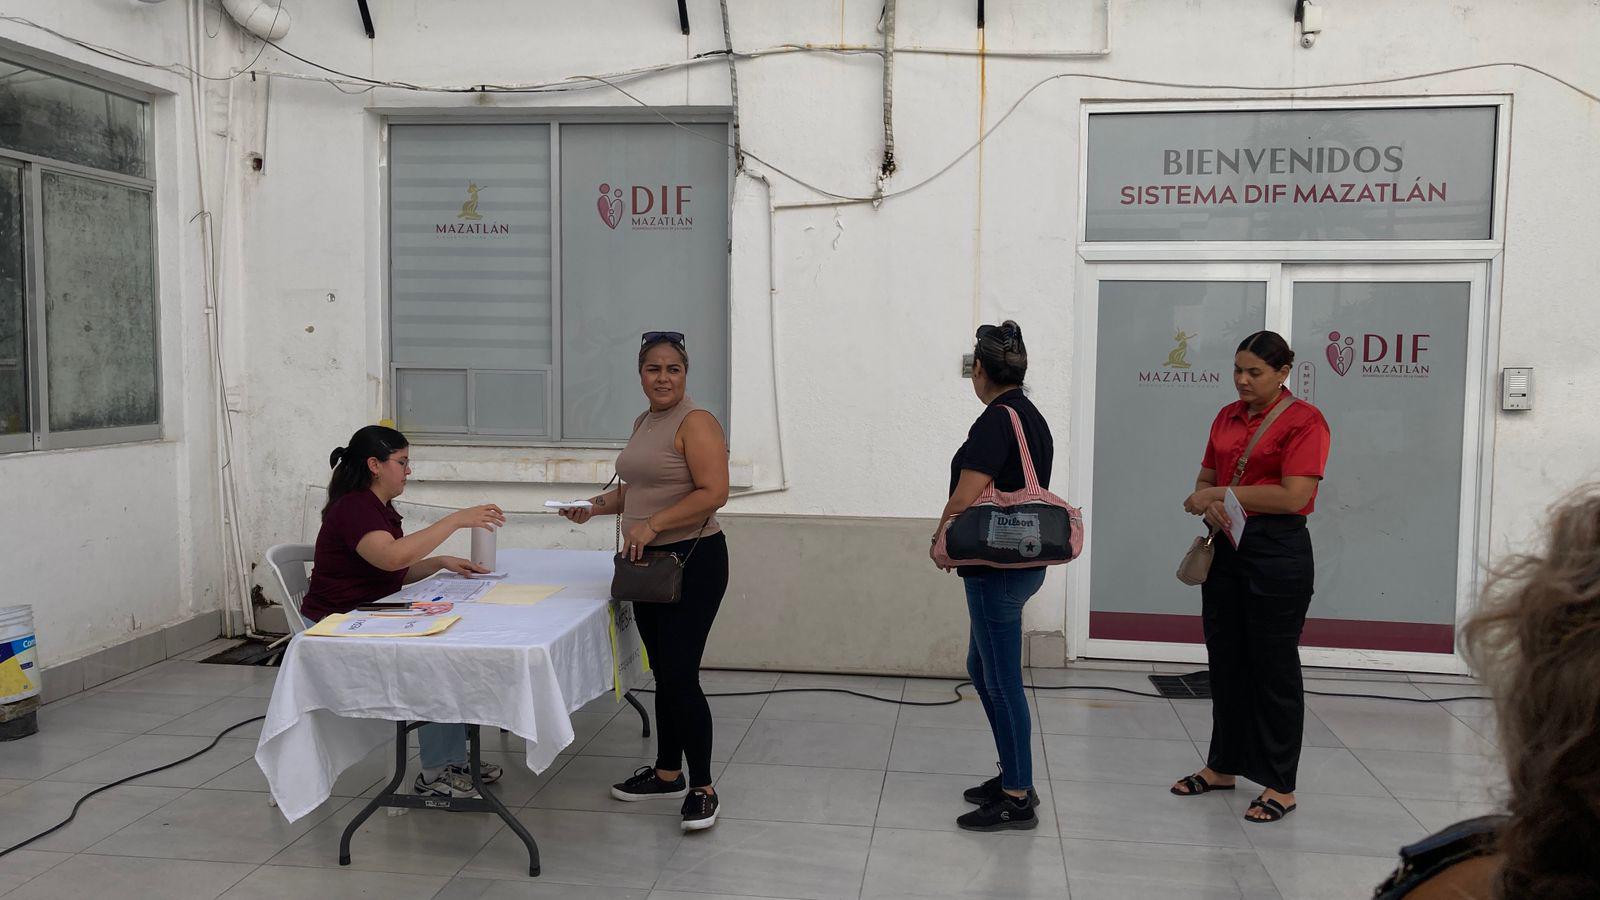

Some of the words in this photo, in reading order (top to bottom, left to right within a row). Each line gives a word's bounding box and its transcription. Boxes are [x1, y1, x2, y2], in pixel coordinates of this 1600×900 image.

[1163, 145, 1403, 175] BIENVENIDOS
[631, 185, 693, 215] DIF
[1120, 184, 1238, 206] SISTEMA
[1244, 184, 1288, 204] DIF
[1293, 177, 1447, 204] MAZATLÁN
[436, 221, 509, 234] MAZATLÁN
[1362, 333, 1431, 363] DIF
[1138, 369, 1220, 383] MAZATLÁN
[997, 516, 1034, 527] Wilson
